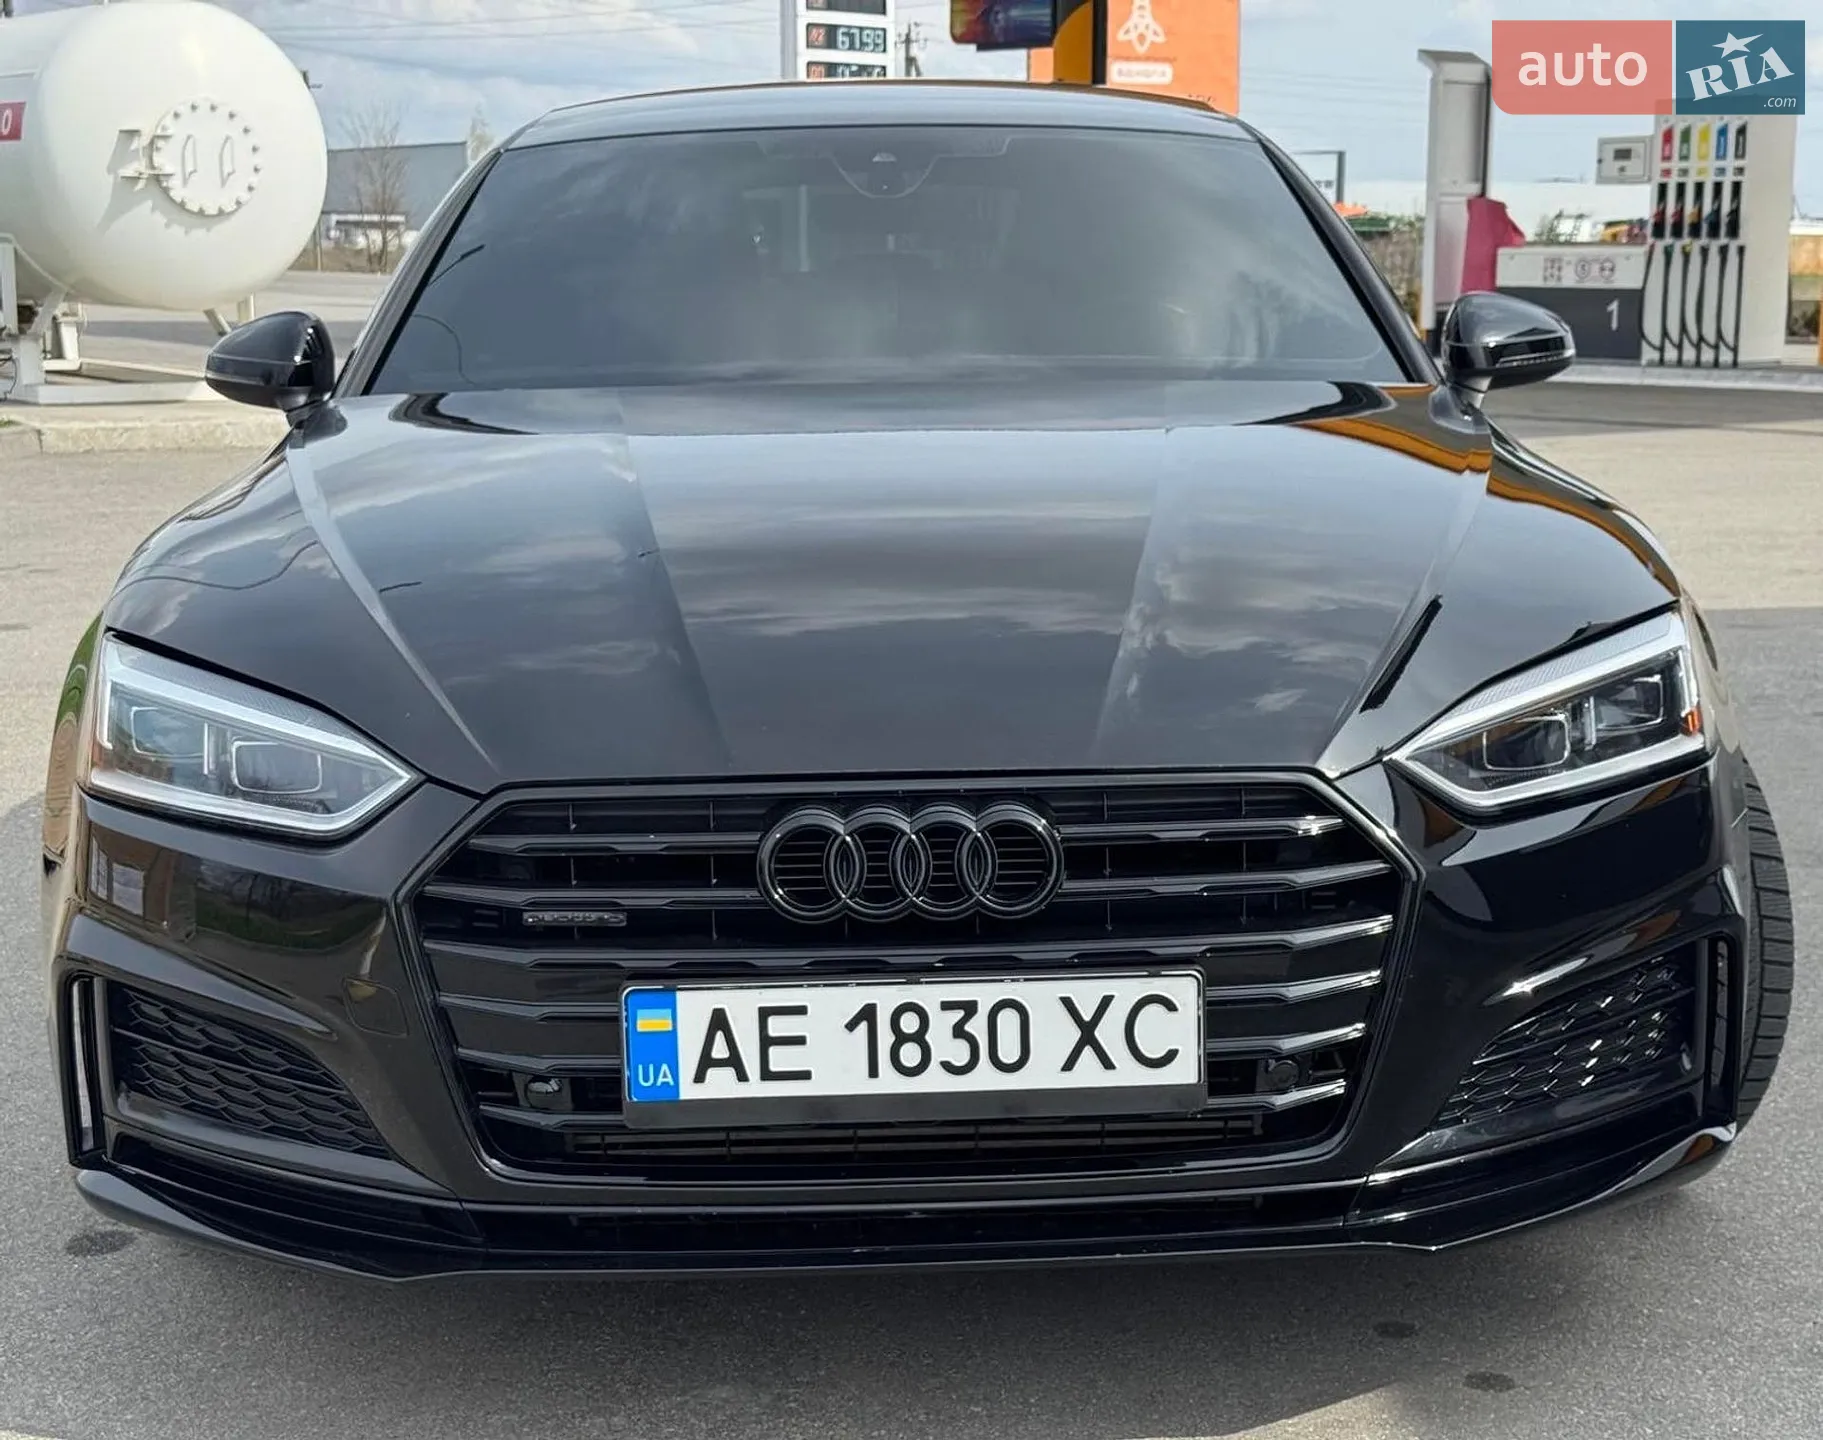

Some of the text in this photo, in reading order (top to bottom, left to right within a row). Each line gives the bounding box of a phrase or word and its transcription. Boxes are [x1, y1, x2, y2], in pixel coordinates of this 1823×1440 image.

[1606, 298, 1620, 331] 1
[693, 993, 1180, 1084] AE 1830 XC
[637, 1063, 675, 1087] UA
